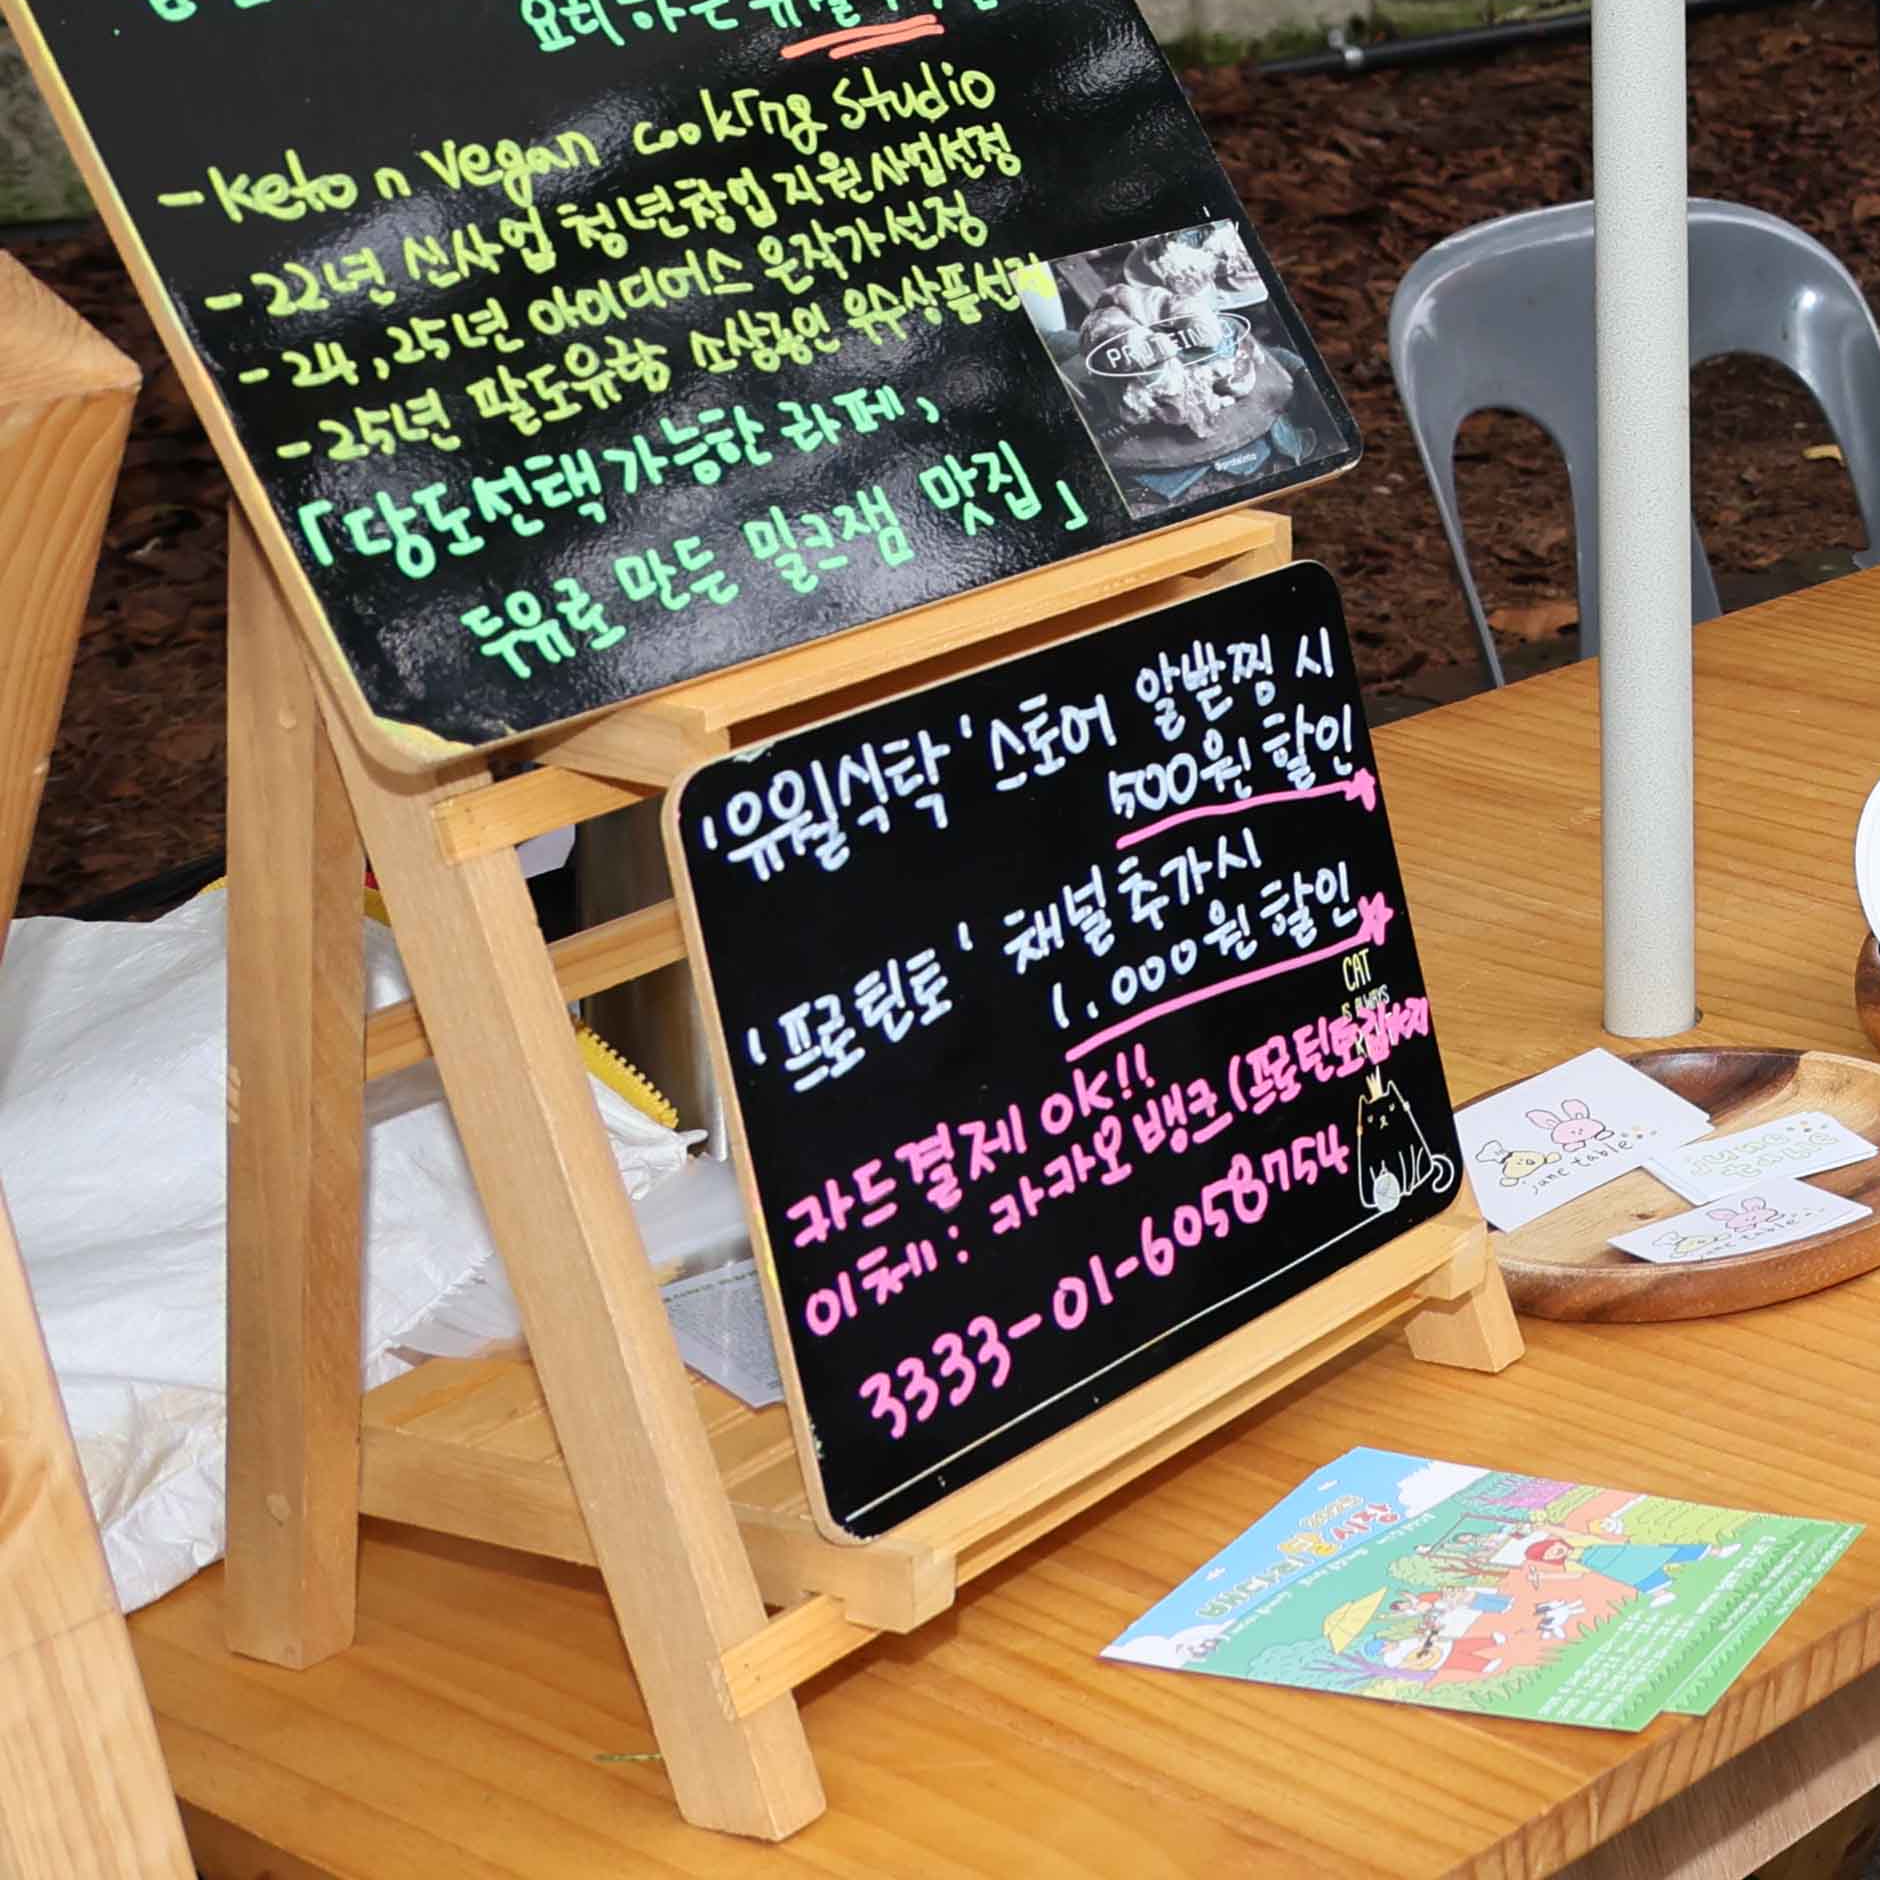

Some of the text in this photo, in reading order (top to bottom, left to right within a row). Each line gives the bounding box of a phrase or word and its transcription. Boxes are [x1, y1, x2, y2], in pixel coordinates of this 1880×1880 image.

[460, 576, 628, 678] 두유로
[614, 535, 740, 611] 만든
[991, 693, 1118, 791] 스토어
[1295, 626, 1335, 679] 시
[1108, 703, 1356, 821] 500원 할인
[1258, 861, 1359, 948] 할인
[1342, 947, 1372, 992] CAT
[858, 1124, 1352, 1441] 3333-01-6058754
